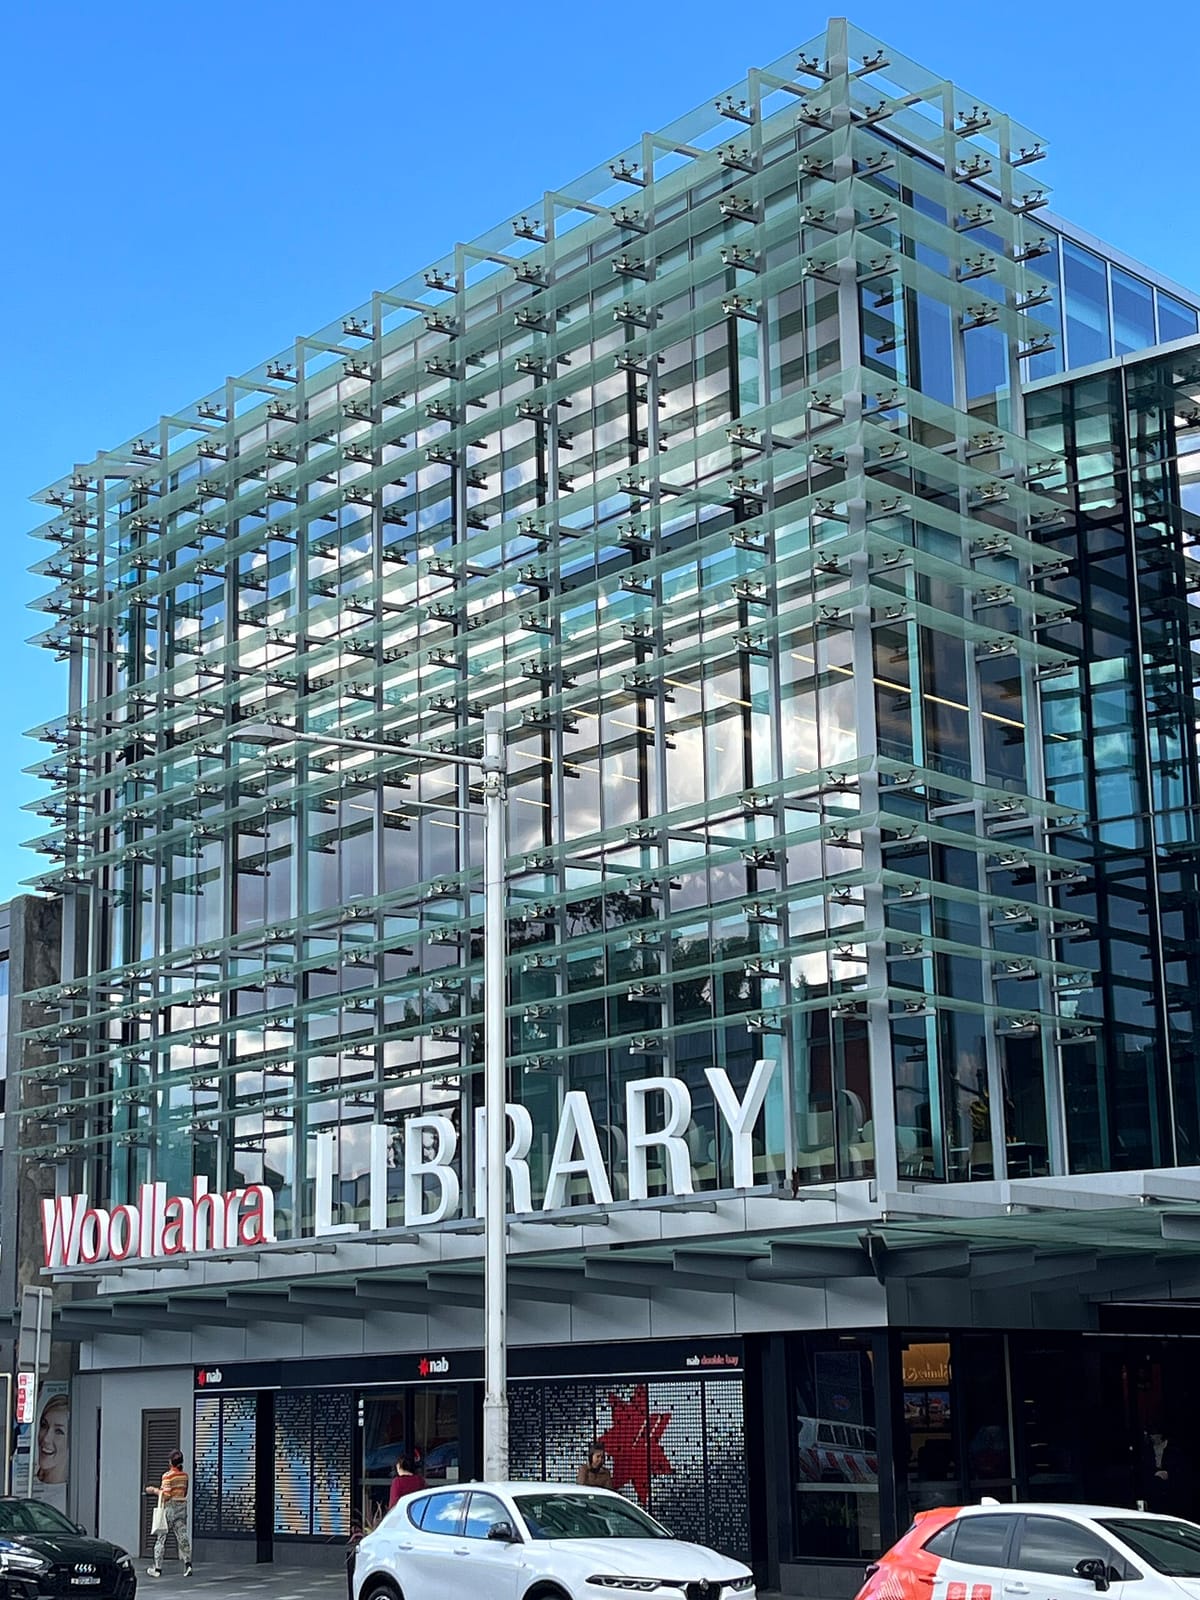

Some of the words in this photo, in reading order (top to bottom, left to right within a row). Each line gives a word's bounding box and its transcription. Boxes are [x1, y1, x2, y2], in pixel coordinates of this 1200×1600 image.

[41, 1176, 276, 1267] Woollahra
[314, 1059, 777, 1237] LIBRARY
[429, 1356, 449, 1373] nab
[686, 1355, 700, 1366] nab
[206, 1368, 222, 1383] nab
